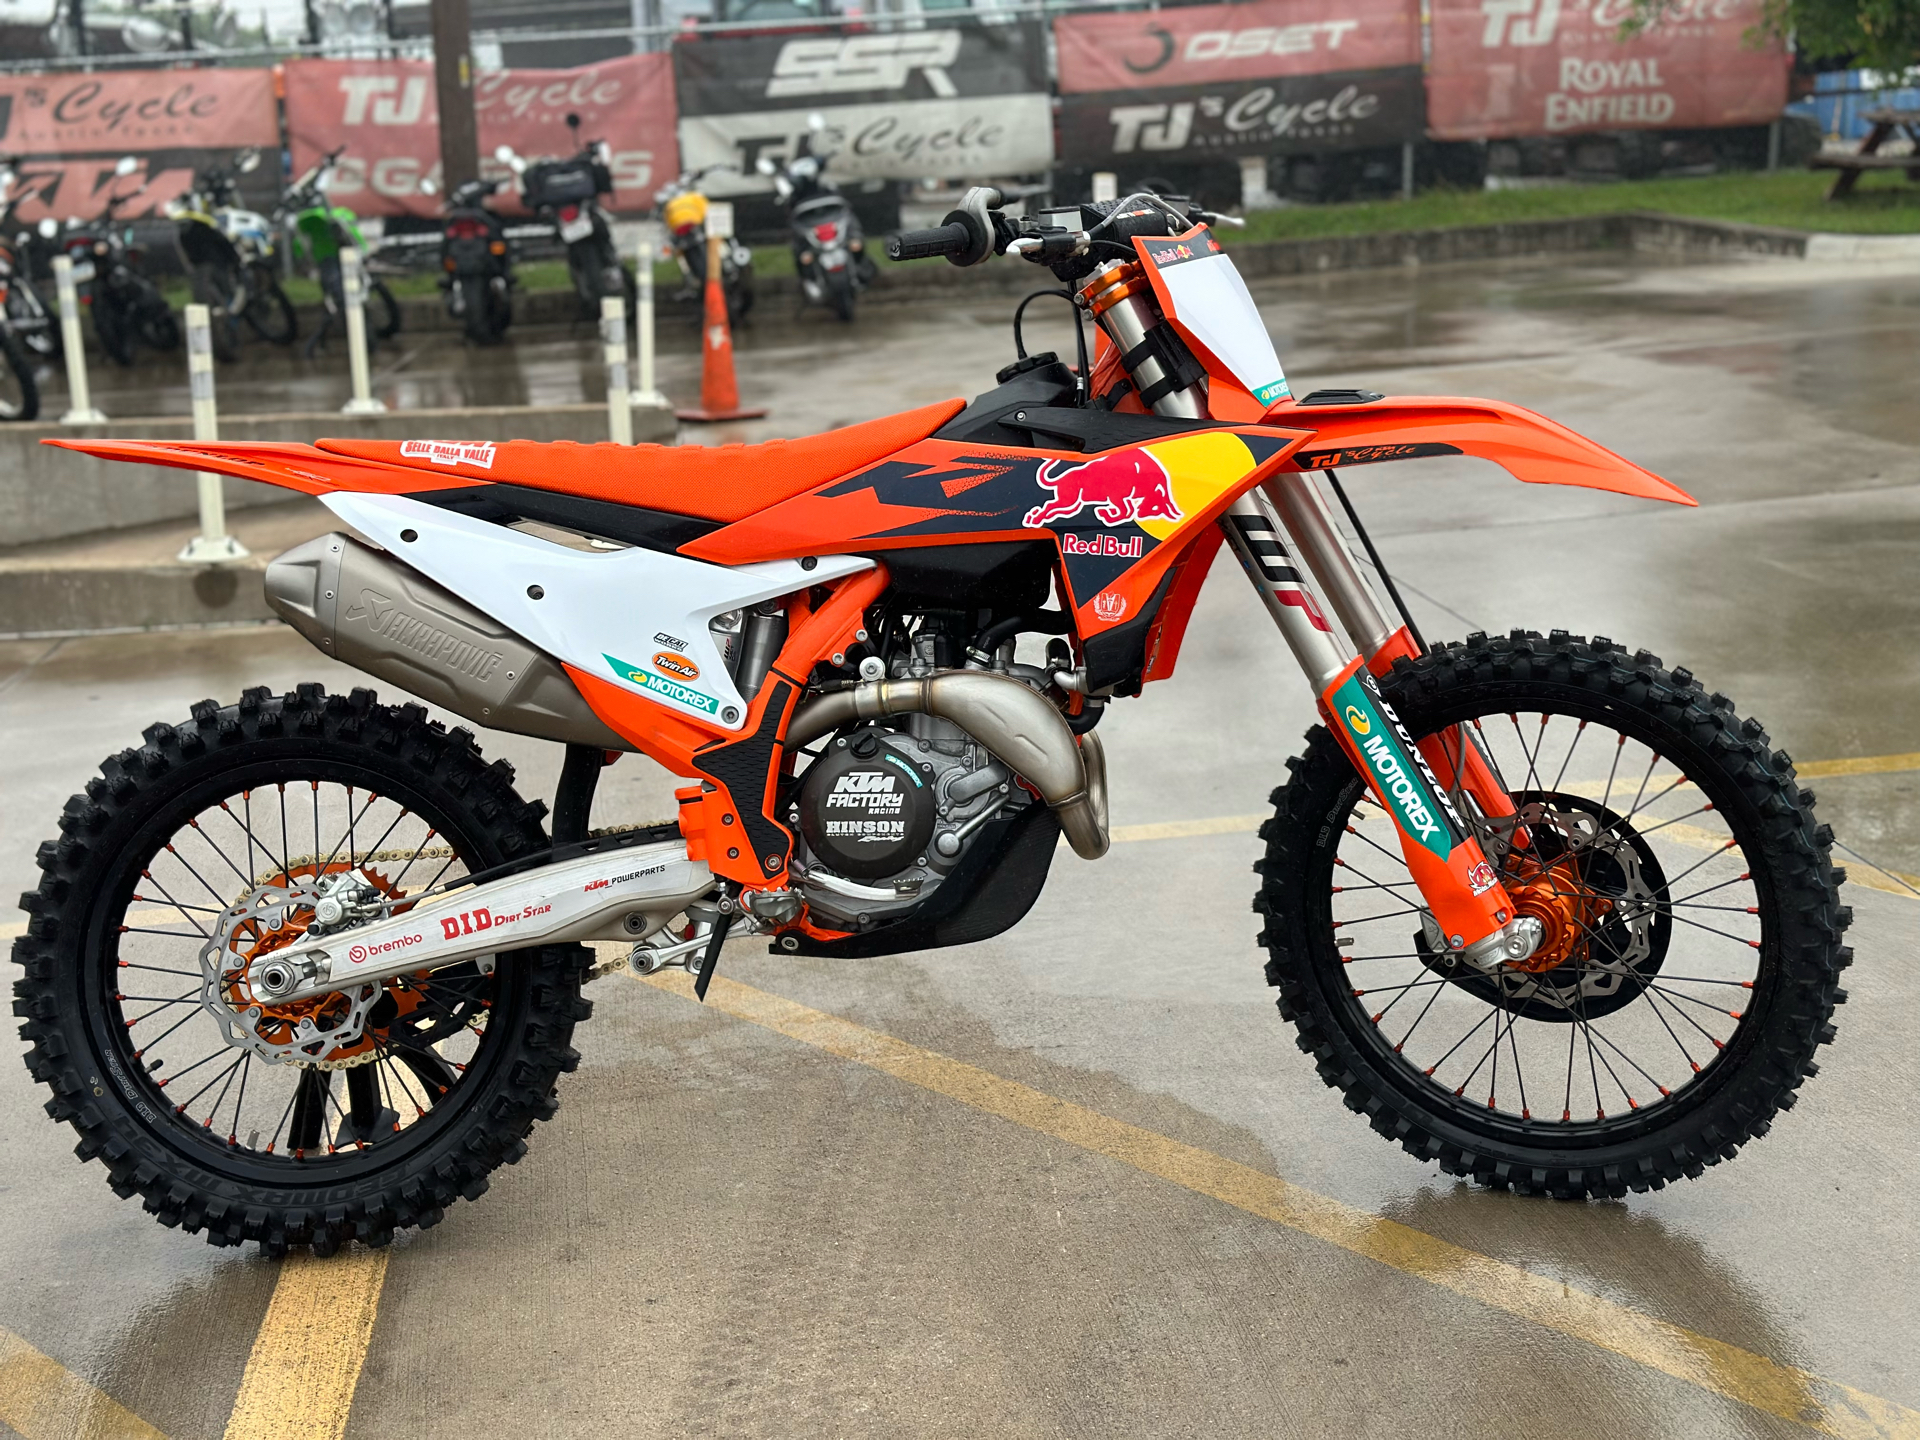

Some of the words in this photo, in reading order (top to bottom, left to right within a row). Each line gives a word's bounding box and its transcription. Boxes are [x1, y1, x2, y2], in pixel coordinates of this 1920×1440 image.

[1184, 20, 1358, 62] OSET
[766, 30, 961, 97] SSR
[1560, 57, 1665, 92] ROYAL
[53, 80, 222, 131] Cycle
[1224, 85, 1380, 136] Cycle
[1545, 93, 1676, 131] ENFIELD
[853, 116, 1004, 163] Cycle
[405, 440, 432, 453] SELLE
[463, 448, 491, 463] VALLE
[1353, 445, 1416, 460] Cycle
[1063, 533, 1103, 555] Red
[1103, 535, 1143, 557] Bull
[656, 655, 681, 672] Twin
[679, 666, 698, 678] Air
[646, 675, 711, 712] MOTOREX
[1378, 699, 1465, 829] DUNLOP
[833, 771, 896, 793] KTM
[1362, 734, 1441, 843] MOTOREX
[826, 793, 905, 807] FACTORY
[826, 821, 905, 833] HINSON
[584, 878, 609, 892] KTM
[611, 864, 666, 885] POWERPARTS
[367, 933, 423, 956] brembo
